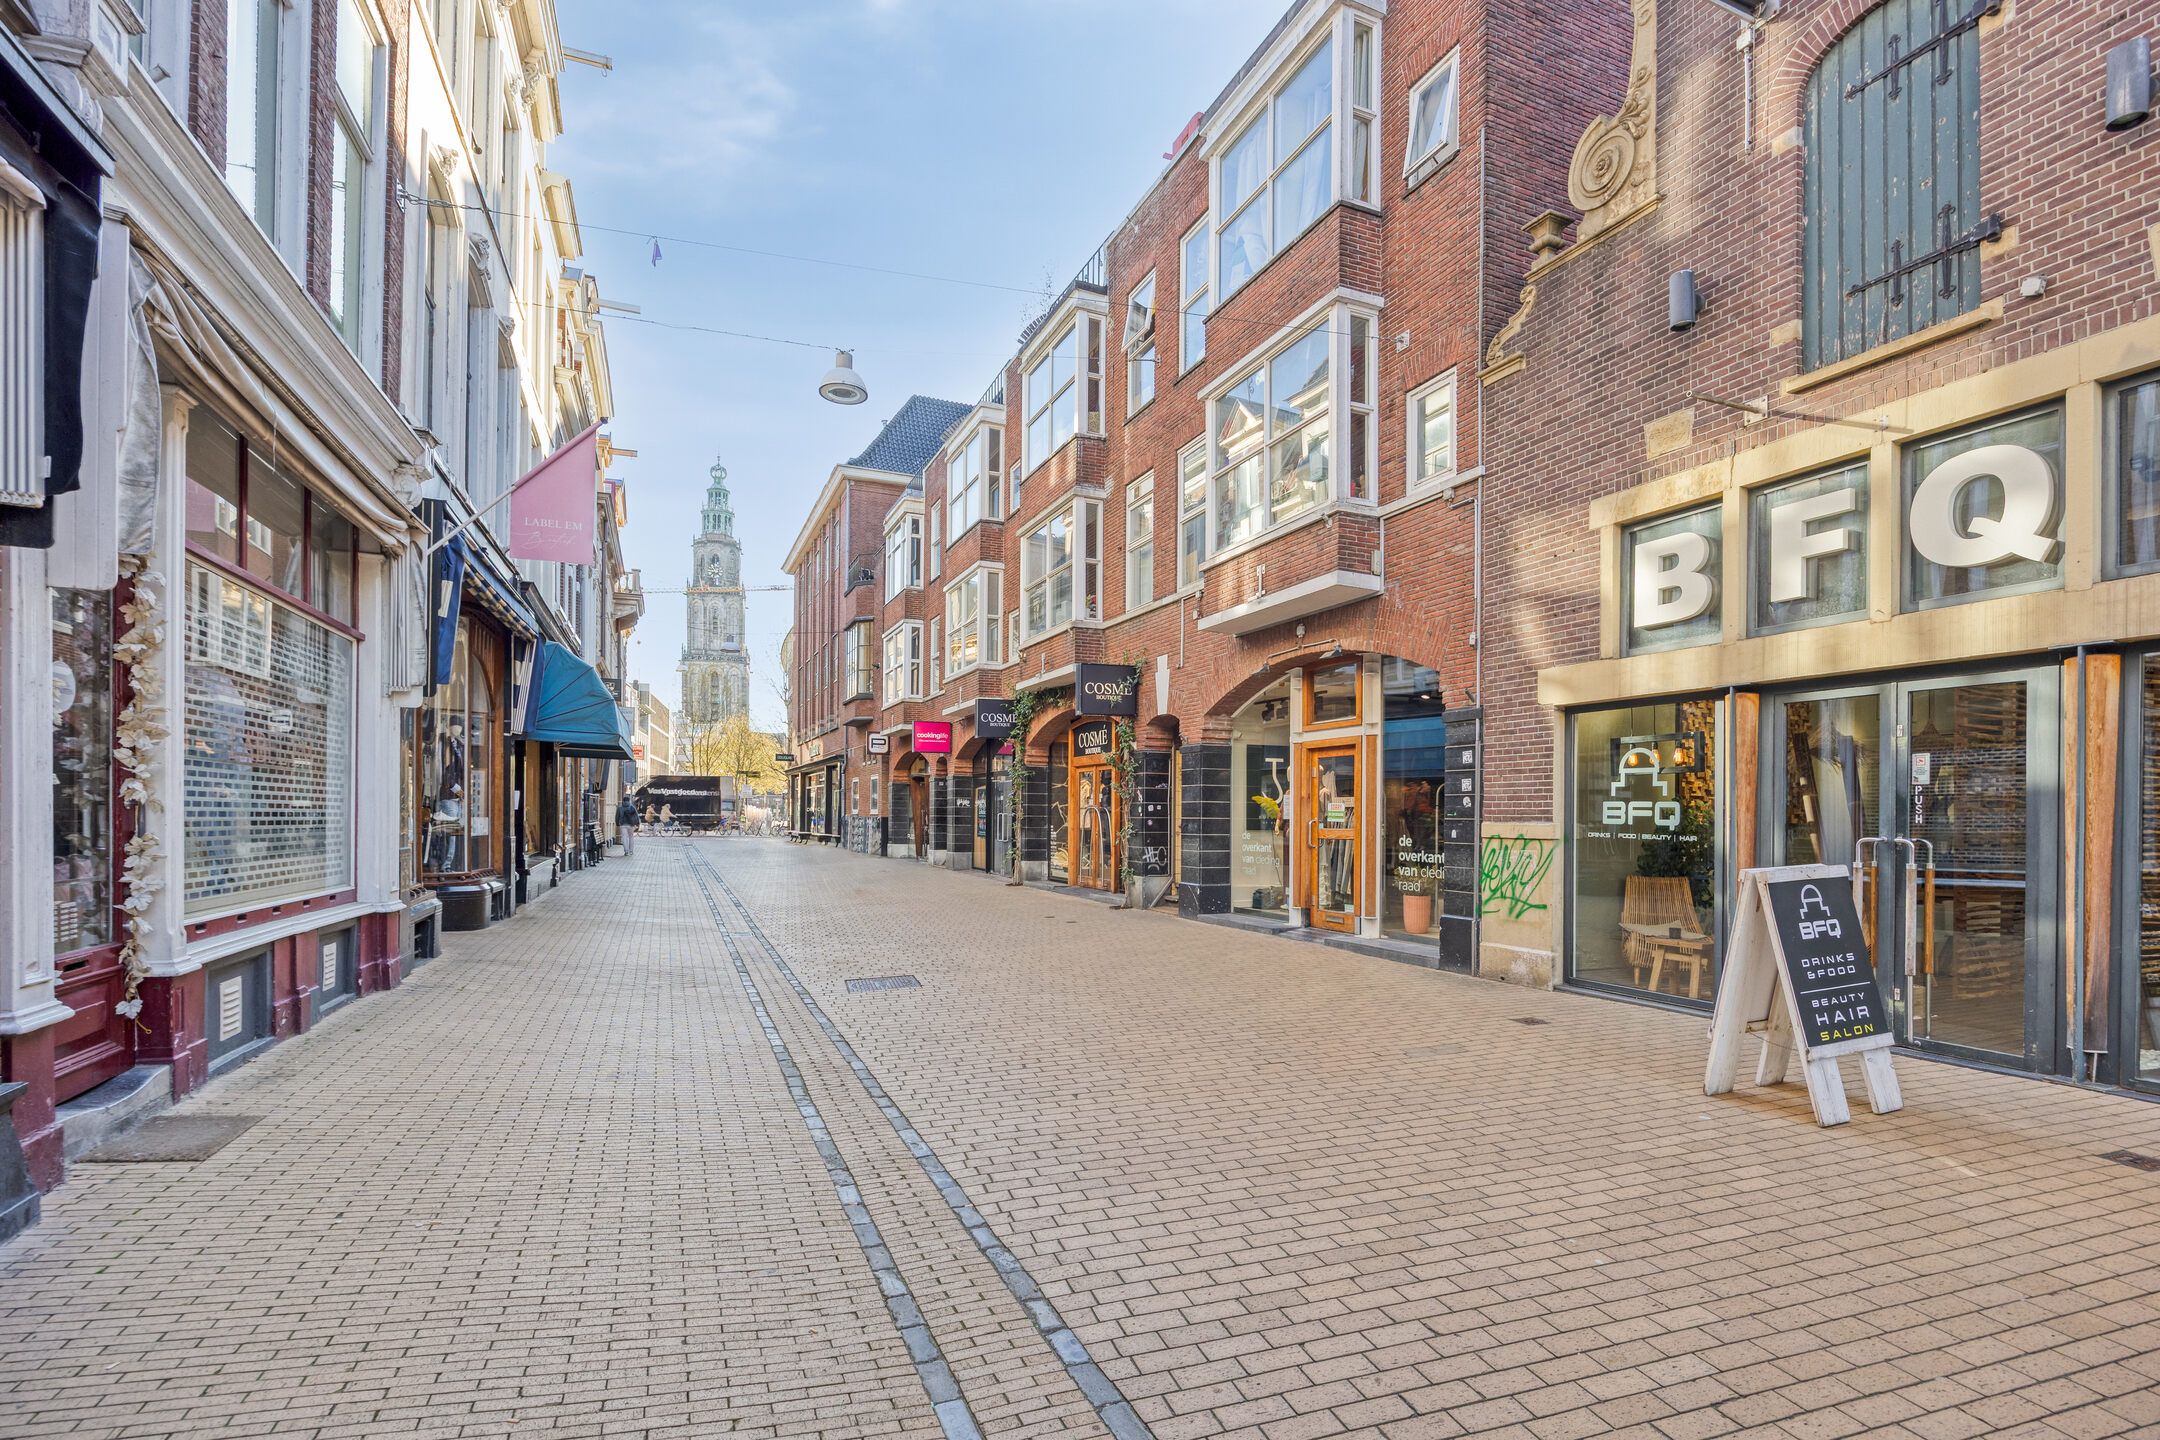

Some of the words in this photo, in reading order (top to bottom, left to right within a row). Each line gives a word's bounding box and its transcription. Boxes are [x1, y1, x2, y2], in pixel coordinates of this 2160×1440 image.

[524, 517, 563, 529] LABEL
[565, 520, 583, 531] EM
[1078, 724, 1109, 749] COSMÉ
[1085, 746, 1102, 756] BOUTIQUE
[1914, 785, 1923, 824] PUSH
[1602, 801, 1681, 831] BFQ
[1242, 842, 1273, 853] overkant
[1398, 834, 1413, 847] de
[1242, 855, 1255, 864] van
[1398, 850, 1445, 864] overkant
[1398, 866, 1418, 877] van
[1398, 880, 1421, 892] raad
[1799, 919, 1842, 940] BFQ
[1801, 952, 1855, 968] DRINKS
[1807, 965, 1856, 980] &FOOD
[1811, 992, 1865, 1008] BEAUTY
[1815, 1005, 1870, 1026] HAIR
[1820, 1023, 1874, 1042] SALON
